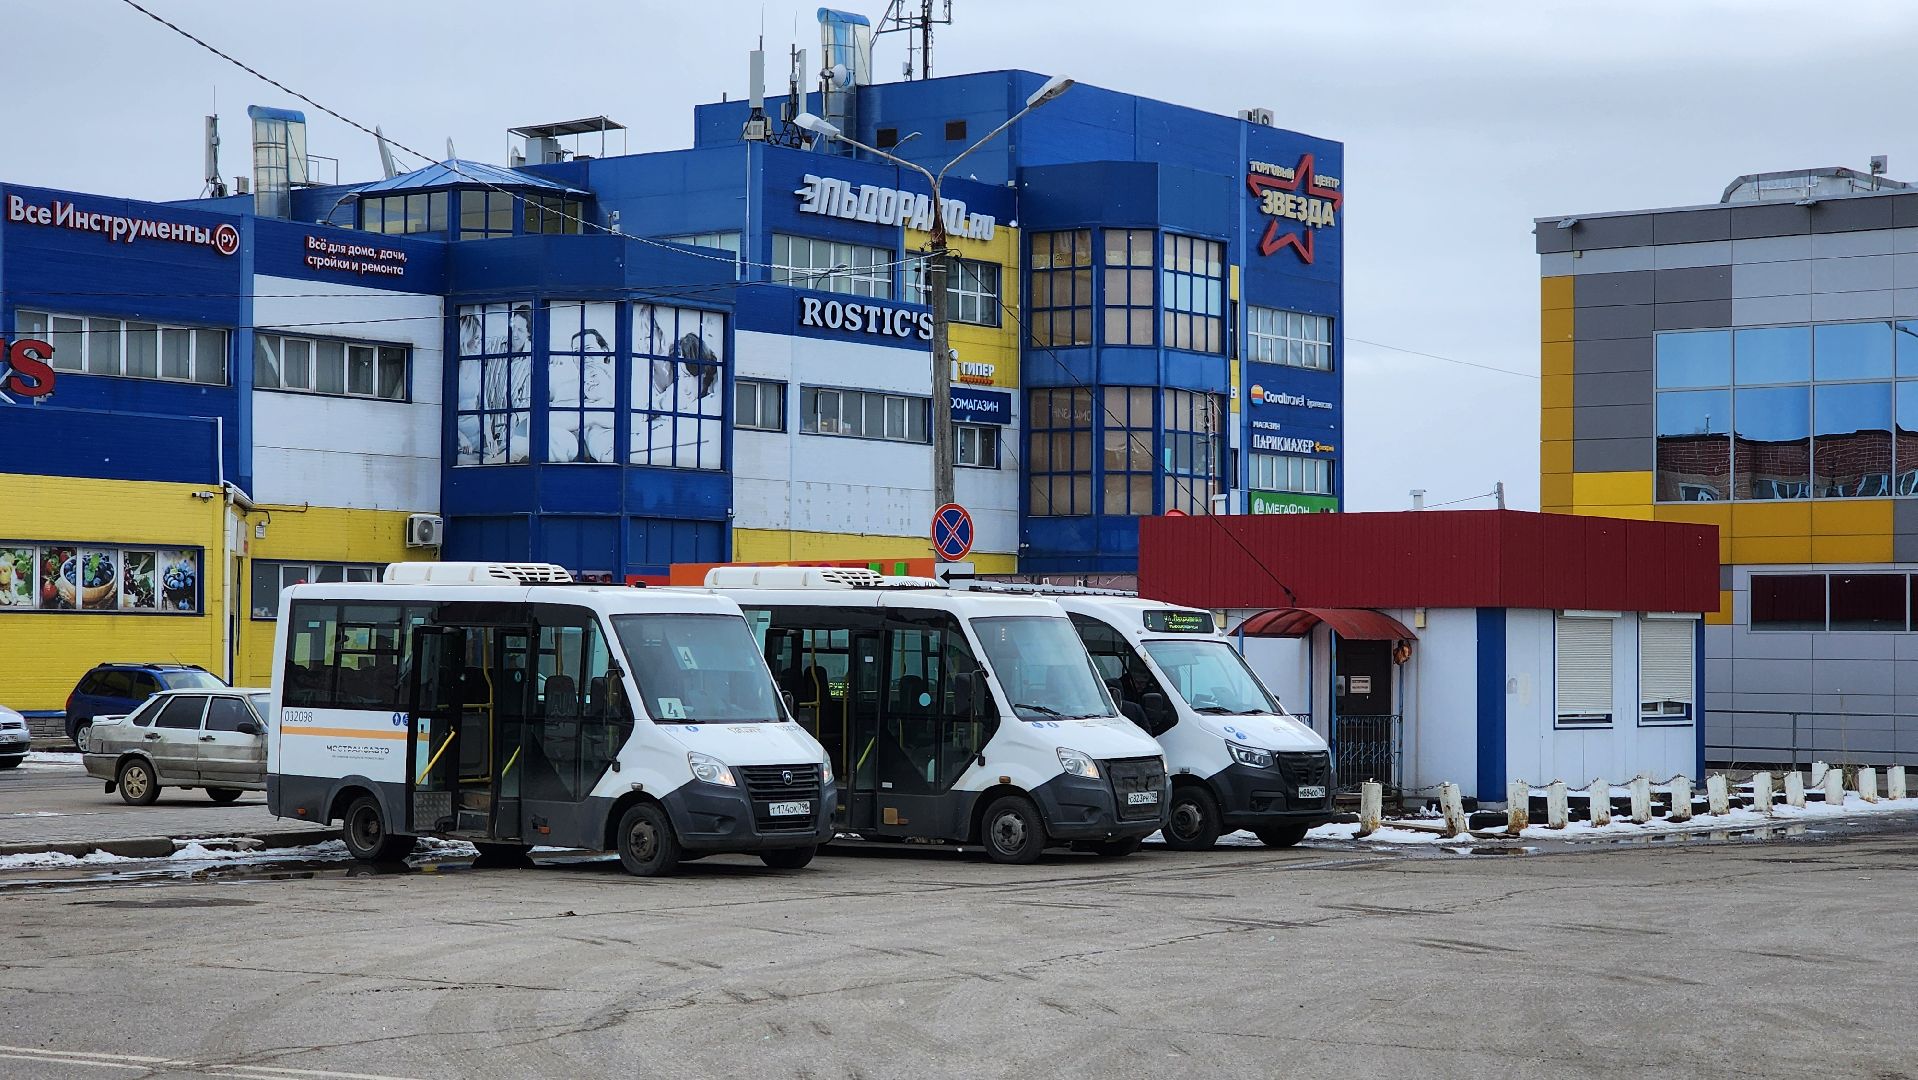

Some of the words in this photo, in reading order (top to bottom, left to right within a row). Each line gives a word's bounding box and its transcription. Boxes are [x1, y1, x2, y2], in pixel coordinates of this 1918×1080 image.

[1249, 160, 1294, 182] ТОРГОВЫЙ
[1314, 174, 1340, 189] ЦЕНТР
[1261, 189, 1335, 228] ЗВЕЗДА
[308, 236, 327, 251] Всё
[328, 243, 346, 254] для
[348, 245, 377, 258] дома,
[380, 249, 408, 262] дачи,
[308, 255, 350, 270] стройки
[351, 261, 359, 271] и
[361, 262, 404, 275] ремонта
[802, 297, 934, 340] ROSTIC'S
[962, 361, 994, 377] ГИПЕР
[950, 397, 998, 412] ООМАГАЗИН
[1253, 420, 1281, 431] МАГАЗИН
[1253, 434, 1314, 453] ПАРИКМАХЕР
